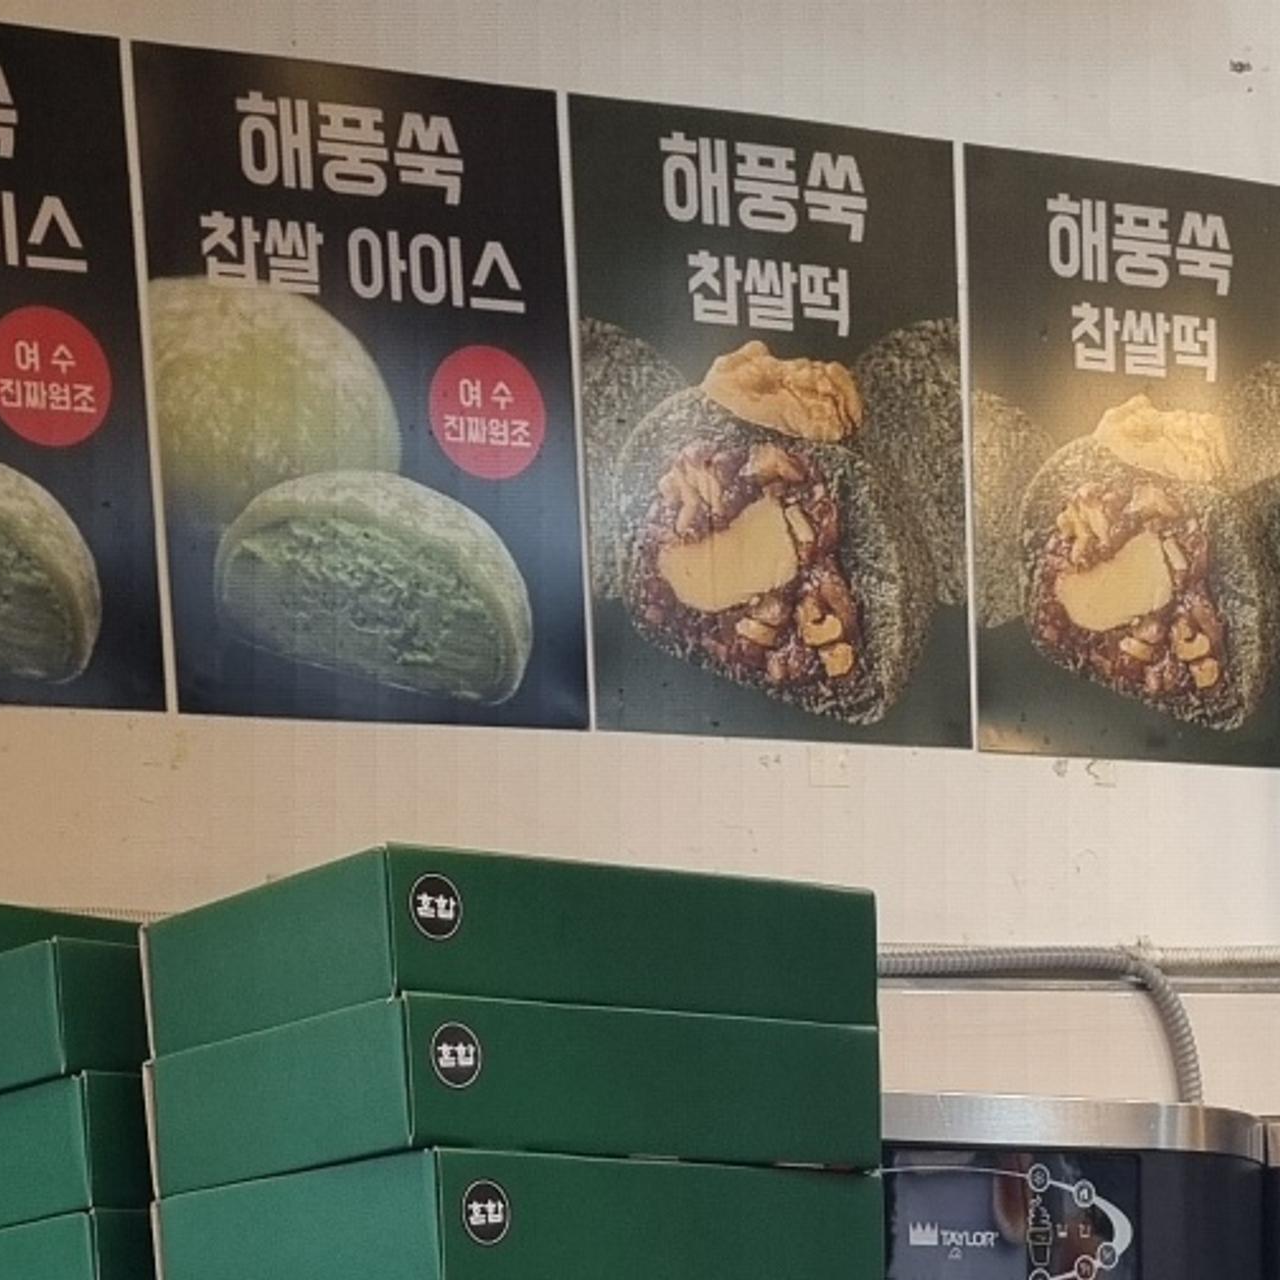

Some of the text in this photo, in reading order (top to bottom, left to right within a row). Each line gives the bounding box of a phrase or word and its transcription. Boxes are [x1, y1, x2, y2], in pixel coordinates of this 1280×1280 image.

[235, 91, 465, 205] 해풍쑥
[660, 131, 868, 242] 해풍쑥
[198, 211, 526, 316] 찹쌀 아이스
[1045, 193, 1234, 297] 해풍쑥
[686, 250, 851, 337] 찹쌀떡
[1070, 302, 1219, 382] 찹쌀떡
[0, 378, 97, 413] 진짜원조
[443, 414, 532, 448] 진짜원조
[940, 1230, 999, 1248] TAYLOR
